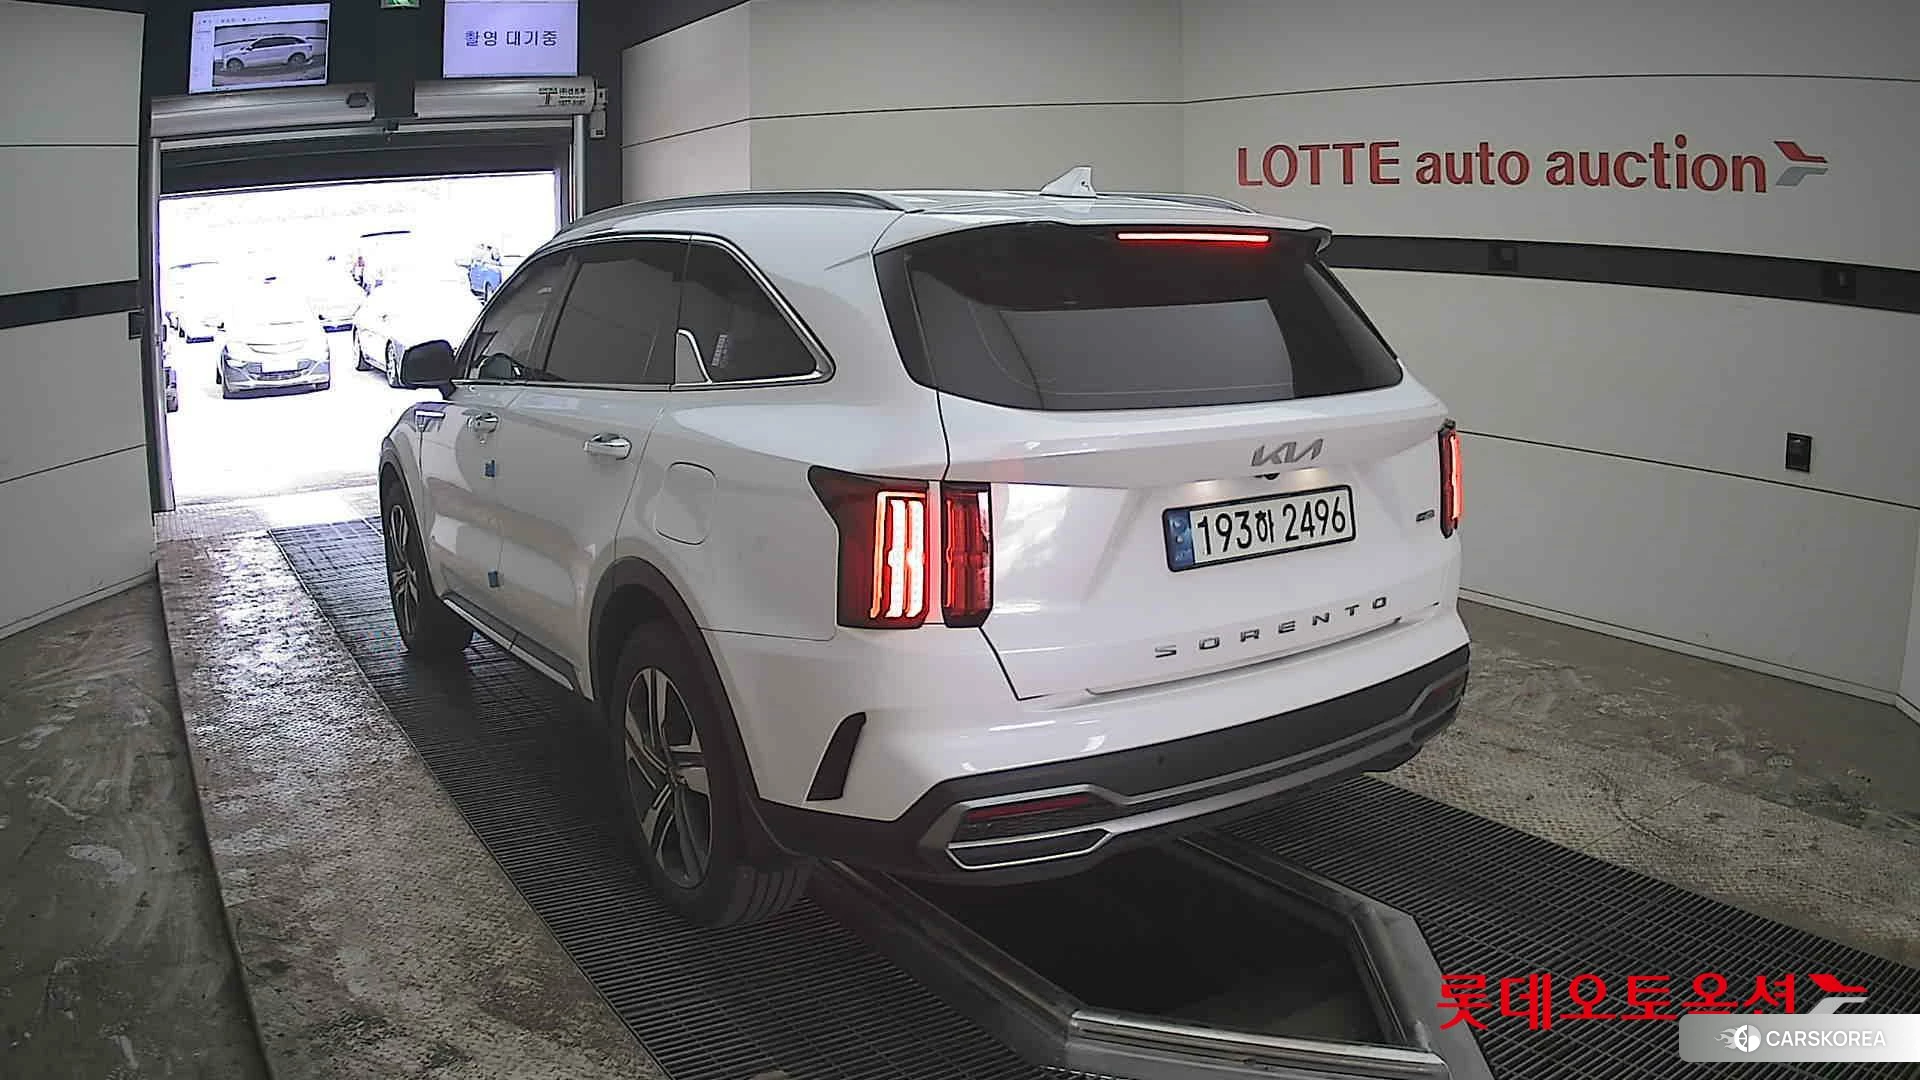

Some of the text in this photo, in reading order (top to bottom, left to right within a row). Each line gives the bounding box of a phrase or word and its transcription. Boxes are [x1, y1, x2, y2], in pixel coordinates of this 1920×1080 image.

[465, 30, 557, 47] 촬영 대기중
[1237, 134, 1767, 193] LOTTE auto auction
[1197, 496, 1346, 556] 193하 2496
[1154, 596, 1388, 659] SORENTO
